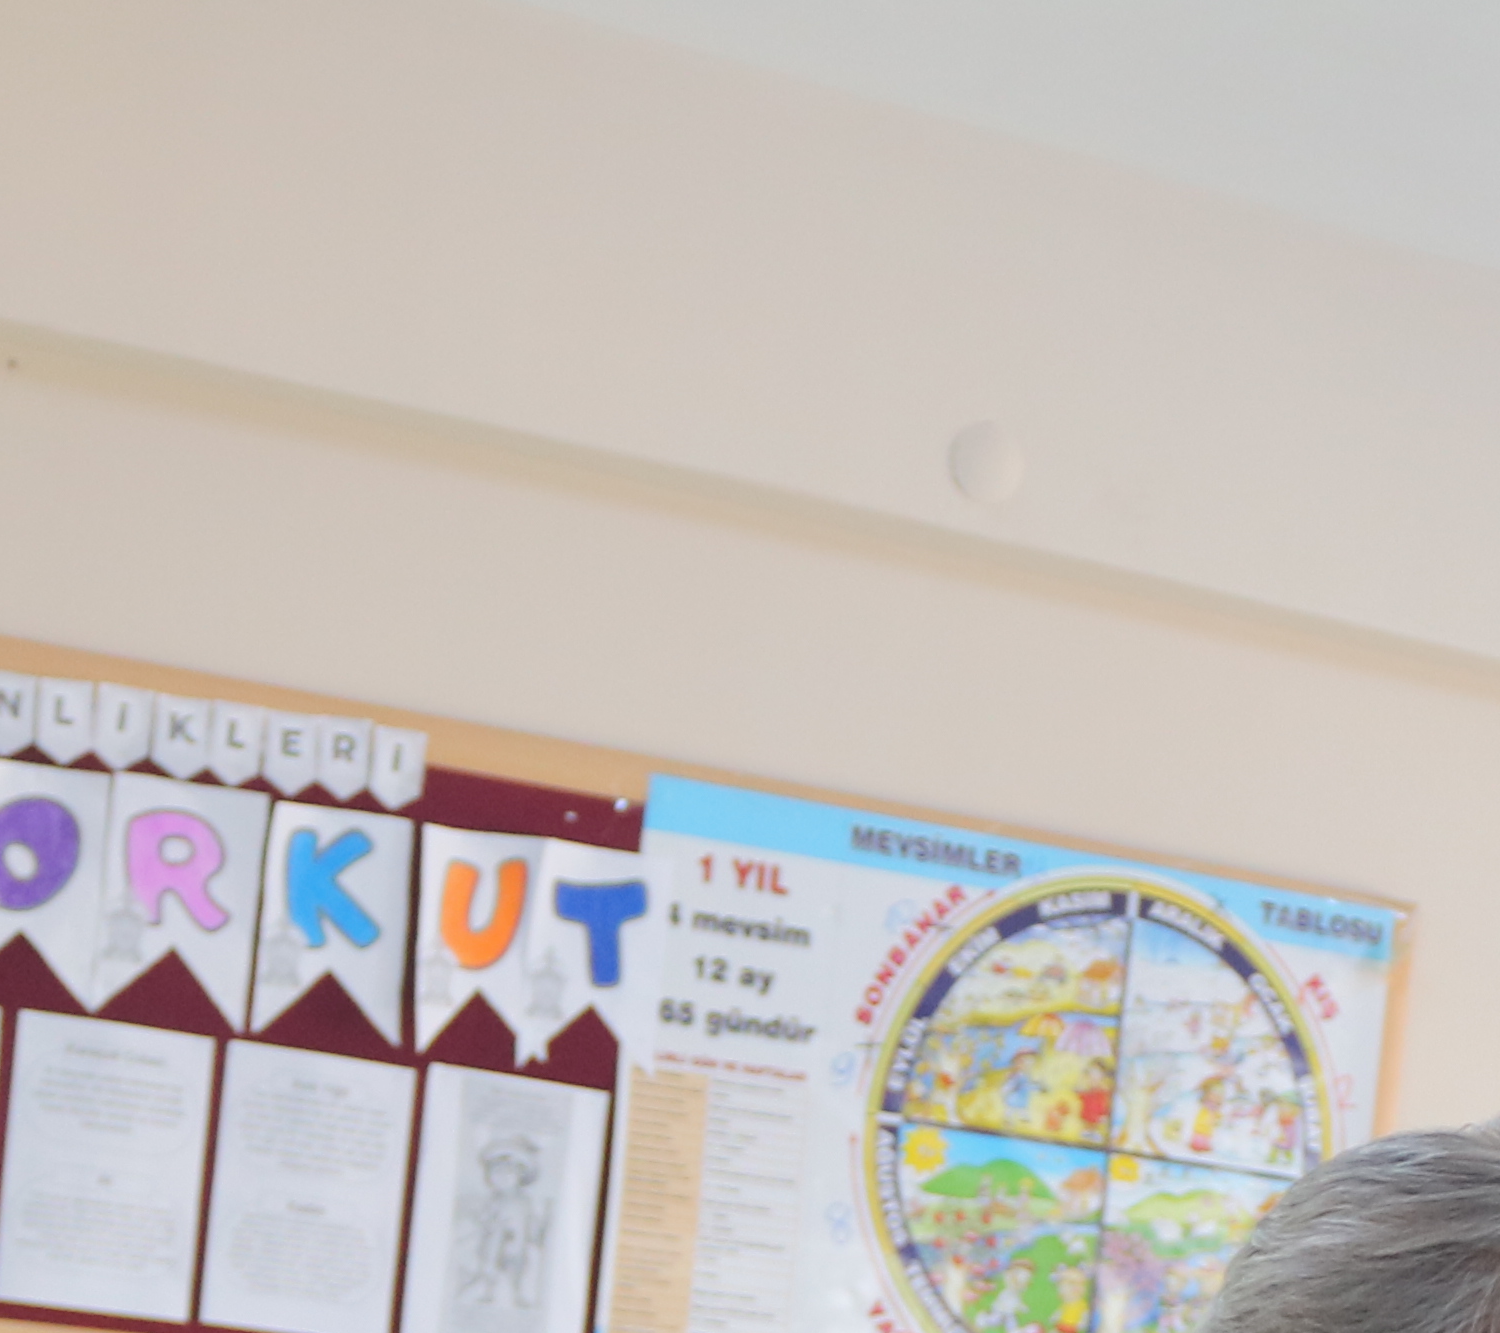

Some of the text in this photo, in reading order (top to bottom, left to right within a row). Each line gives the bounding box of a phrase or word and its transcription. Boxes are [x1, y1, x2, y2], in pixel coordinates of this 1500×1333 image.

[700, 856, 789, 896] 1 YIL
[851, 824, 1383, 945] MEVSİMLER TABLOSU
[692, 910, 811, 947] mevsim
[694, 956, 775, 996] 12 ay
[705, 1008, 816, 1043] gündür
